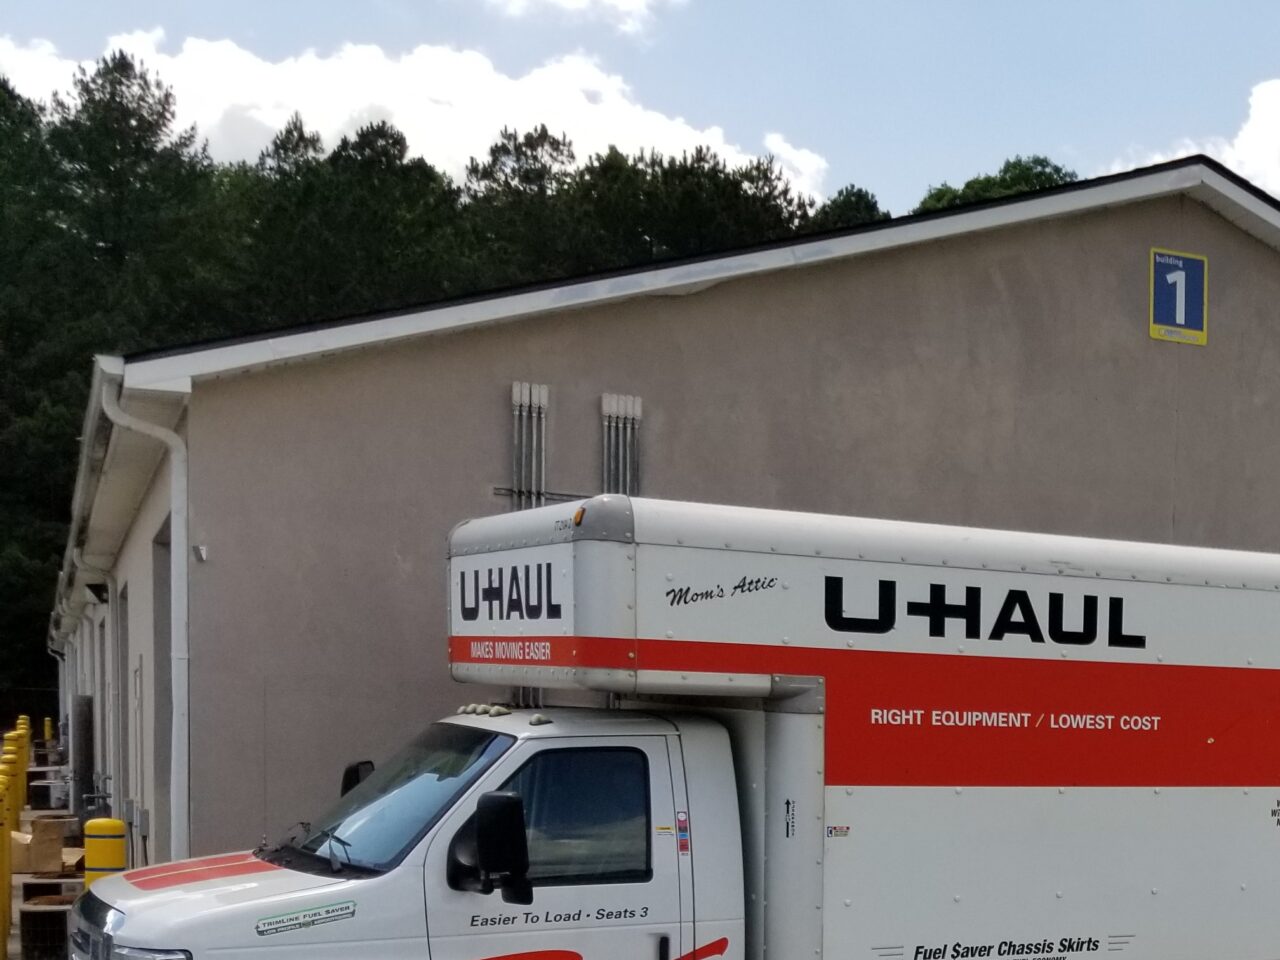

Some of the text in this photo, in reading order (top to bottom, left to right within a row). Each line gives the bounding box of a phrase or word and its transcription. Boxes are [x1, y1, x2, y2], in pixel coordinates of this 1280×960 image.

[1166, 270, 1186, 325] 1
[460, 562, 562, 621] U-HAUL
[666, 576, 776, 606] Mom's Attic
[824, 575, 1147, 649] U-HAUL
[471, 642, 551, 660] MAKES MOVING EASIER
[871, 708, 1161, 731] RIGHT EQUIPMENT / LOWEST COST
[262, 916, 300, 928] TRIMLINE
[303, 912, 322, 920] FUEL
[324, 905, 350, 915] SAVER
[470, 906, 649, 927] Easier To Load Seats 3
[913, 936, 1100, 960] Fuel $aver Chassis Skirts
